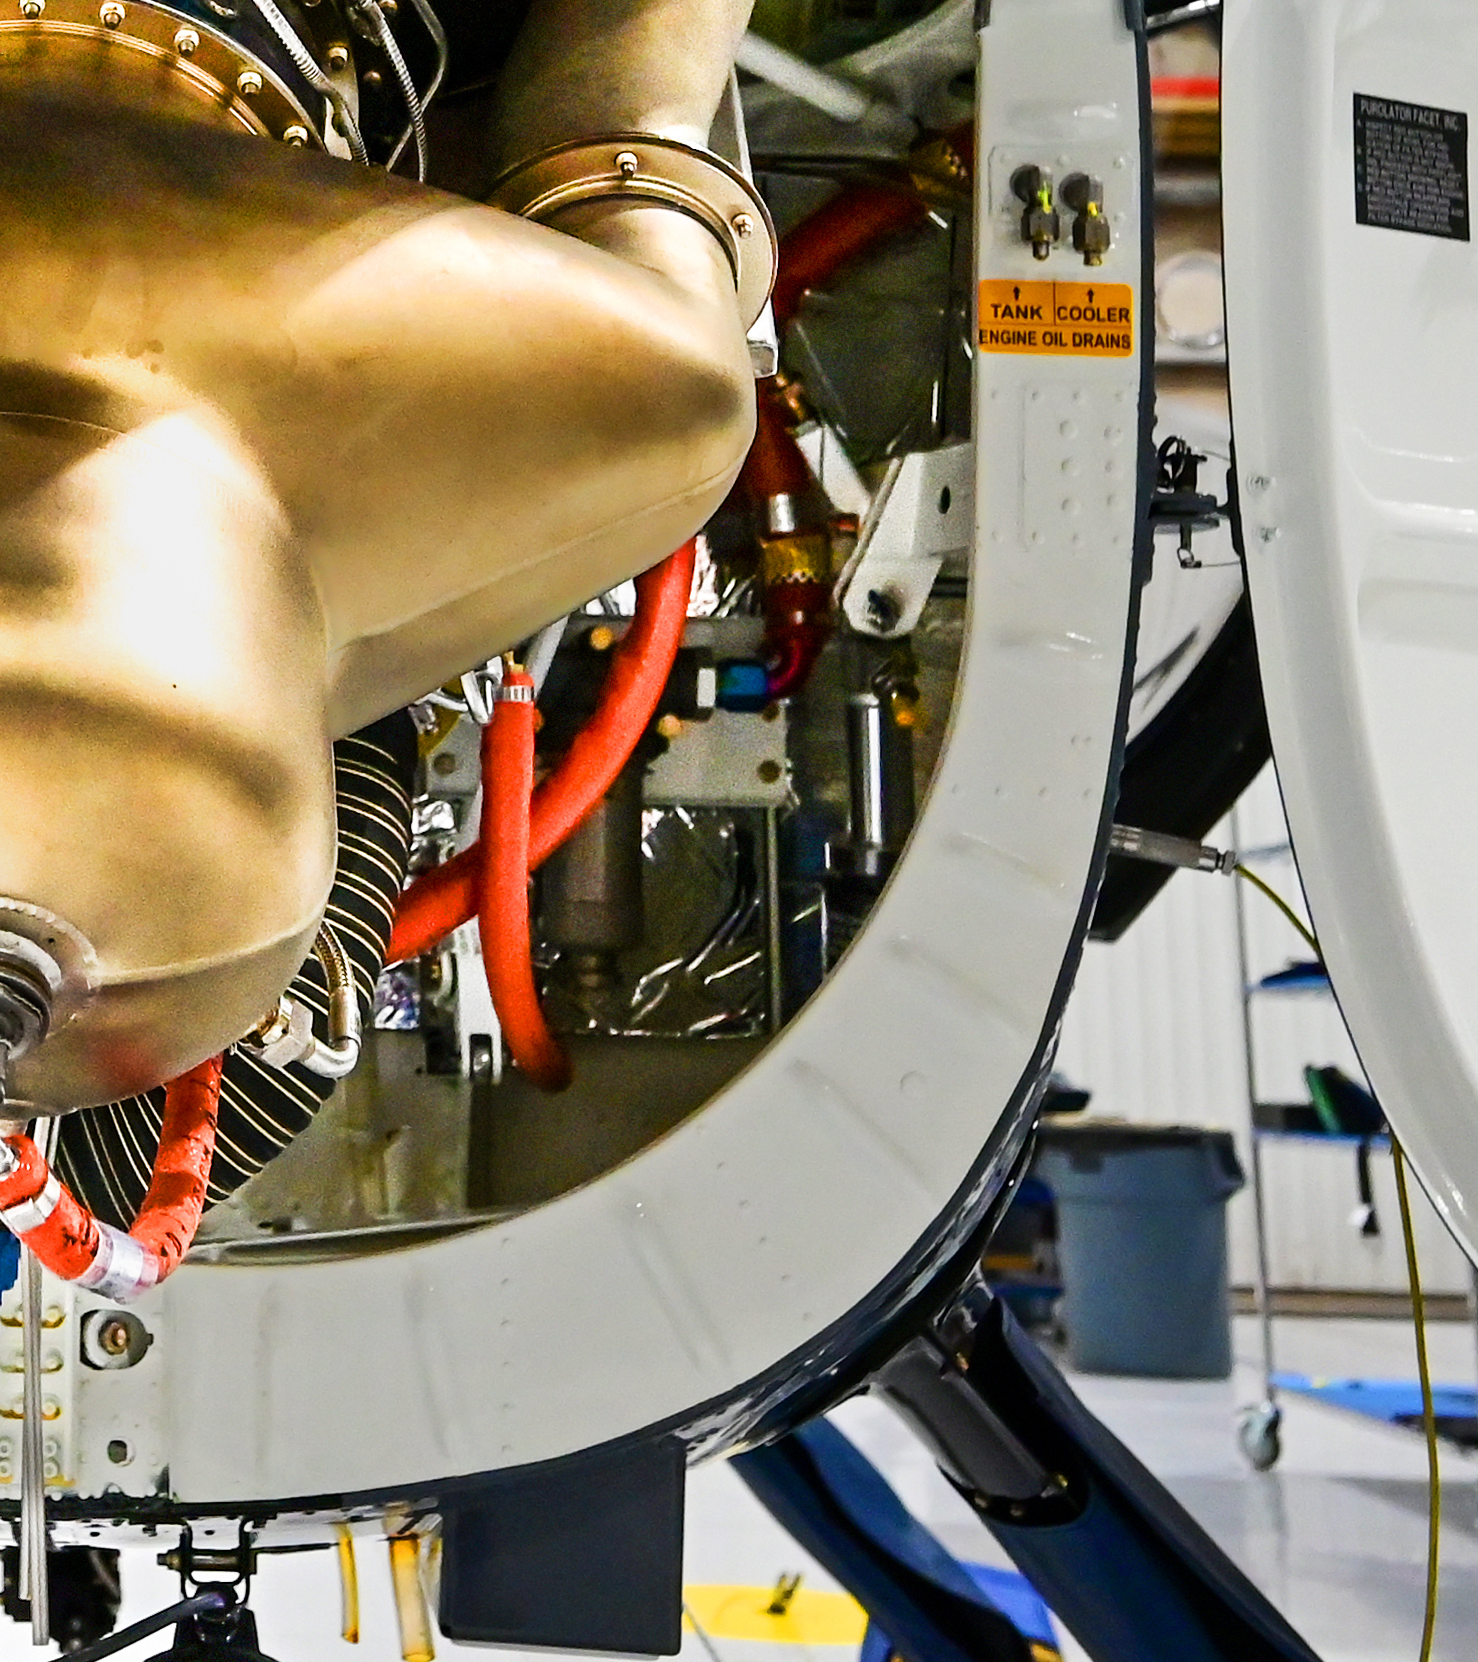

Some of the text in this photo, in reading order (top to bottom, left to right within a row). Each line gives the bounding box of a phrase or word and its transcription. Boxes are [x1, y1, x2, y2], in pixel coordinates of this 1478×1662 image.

[991, 303, 1044, 320] TANK
[1057, 305, 1131, 324] COOLER
[979, 328, 1131, 350] ENGINE OIL DRAINS
